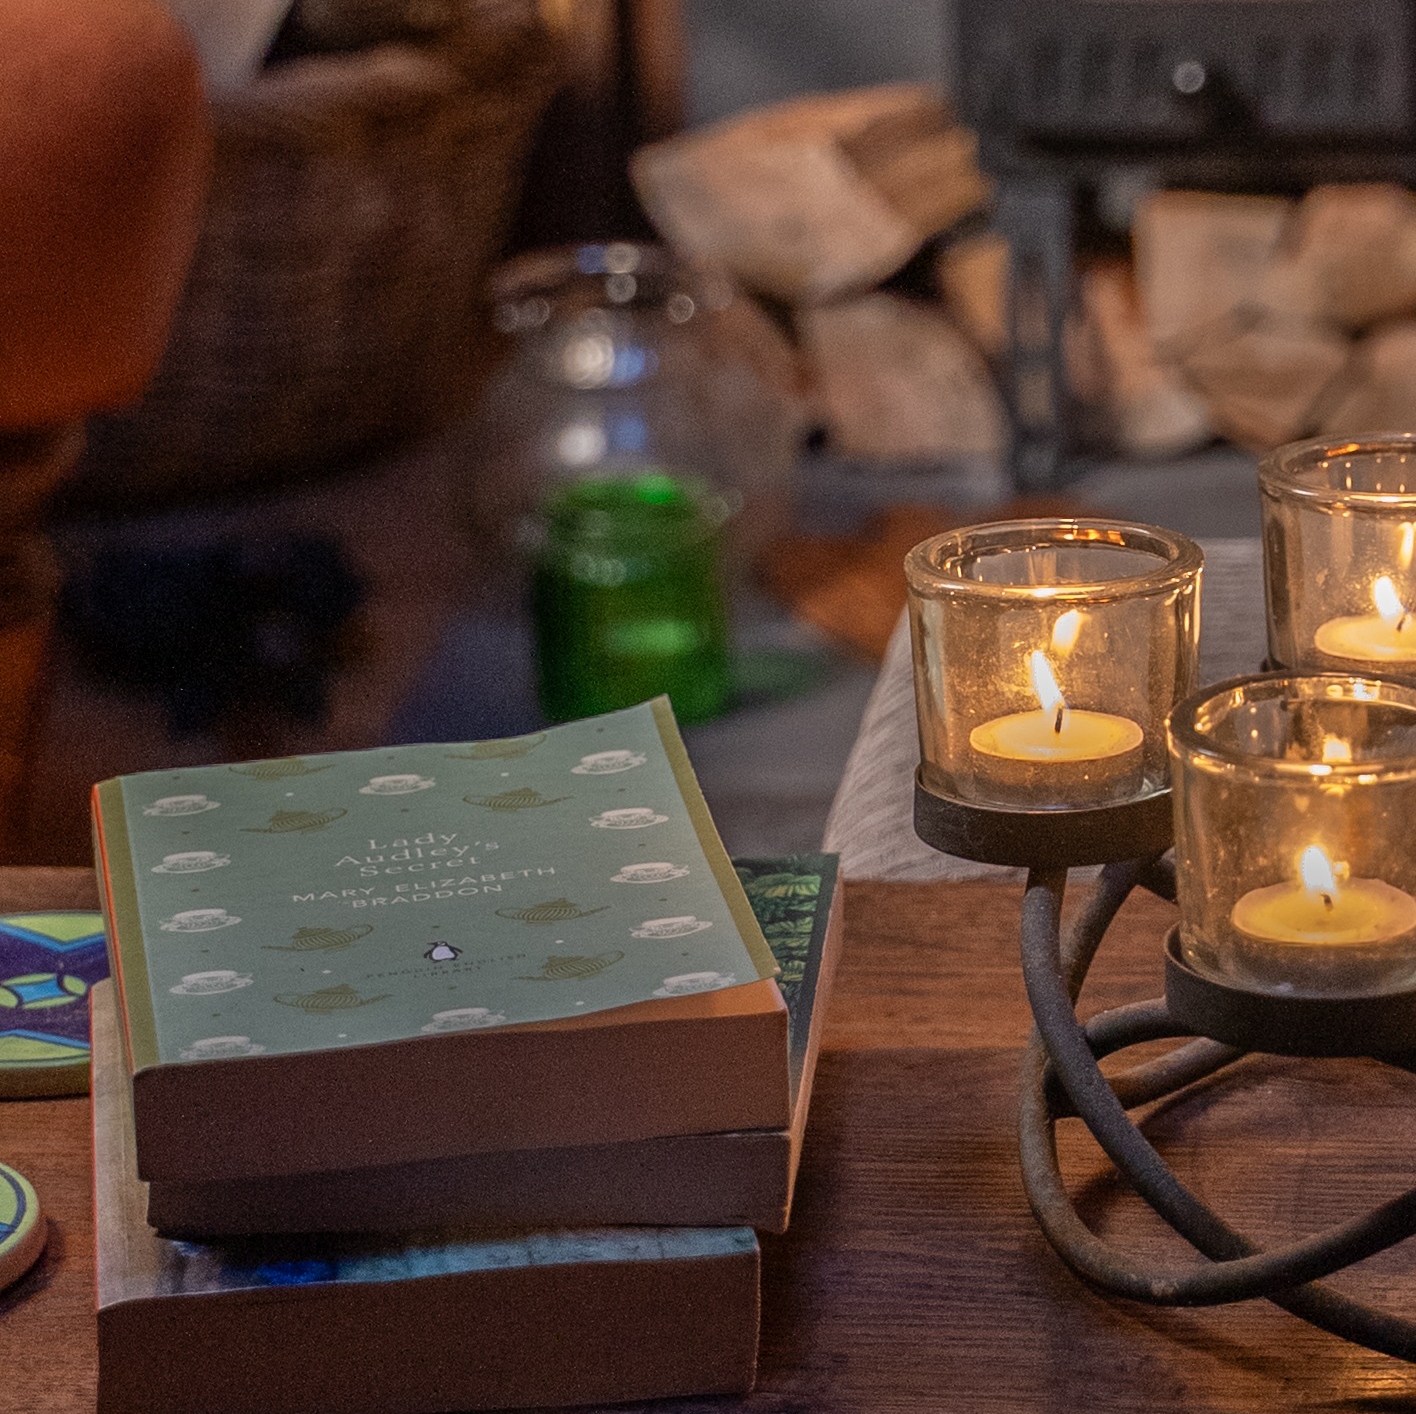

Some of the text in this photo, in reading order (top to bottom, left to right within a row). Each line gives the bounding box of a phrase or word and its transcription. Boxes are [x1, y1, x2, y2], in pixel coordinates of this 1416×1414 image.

[369, 832, 458, 850] Lady
[335, 841, 500, 867] Audley's
[359, 856, 481, 877] Secret
[292, 867, 556, 902] MARY ELIZABETH
[352, 884, 503, 908] BRADDON
